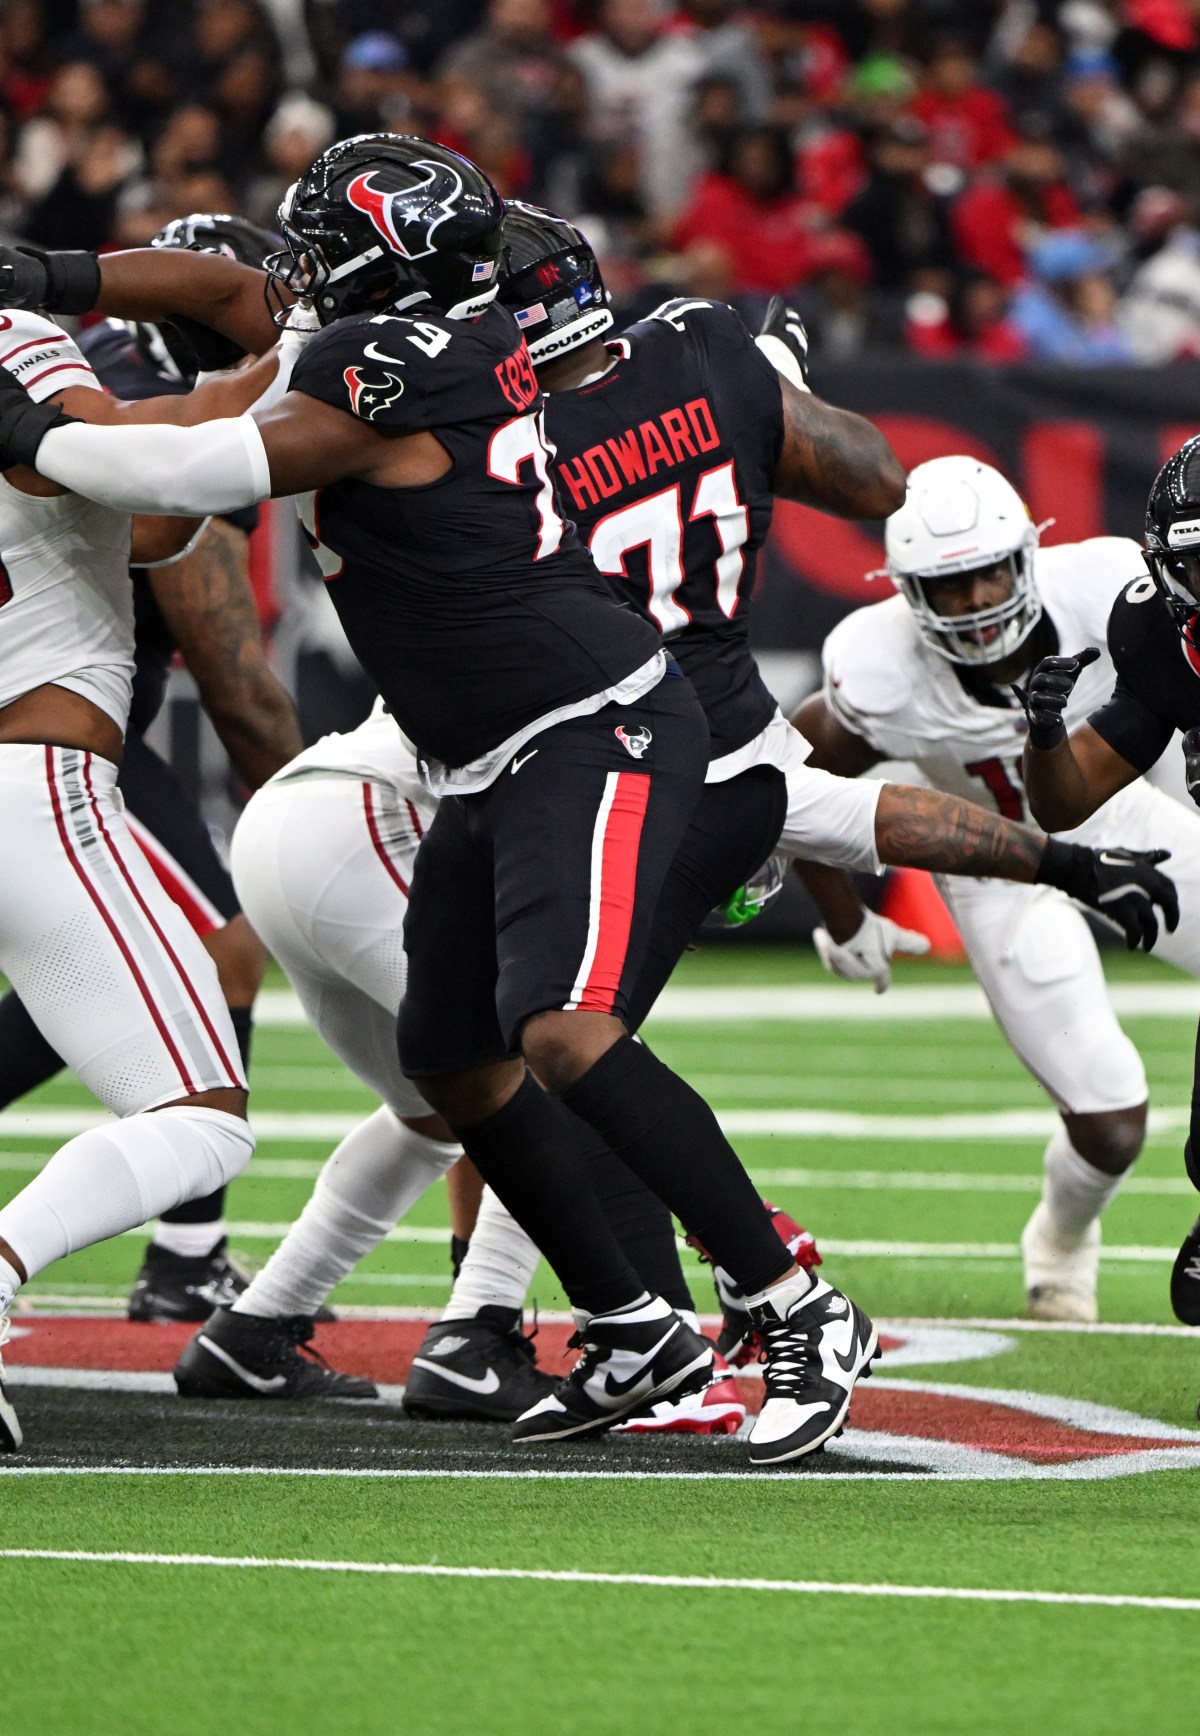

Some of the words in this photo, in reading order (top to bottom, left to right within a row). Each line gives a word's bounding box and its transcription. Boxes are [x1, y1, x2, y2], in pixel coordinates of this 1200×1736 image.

[10, 350, 61, 377] DINALS
[494, 334, 539, 412] ERS
[531, 315, 608, 360] HOUSTON
[558, 397, 720, 512] HOWARD
[588, 457, 750, 636] 71
